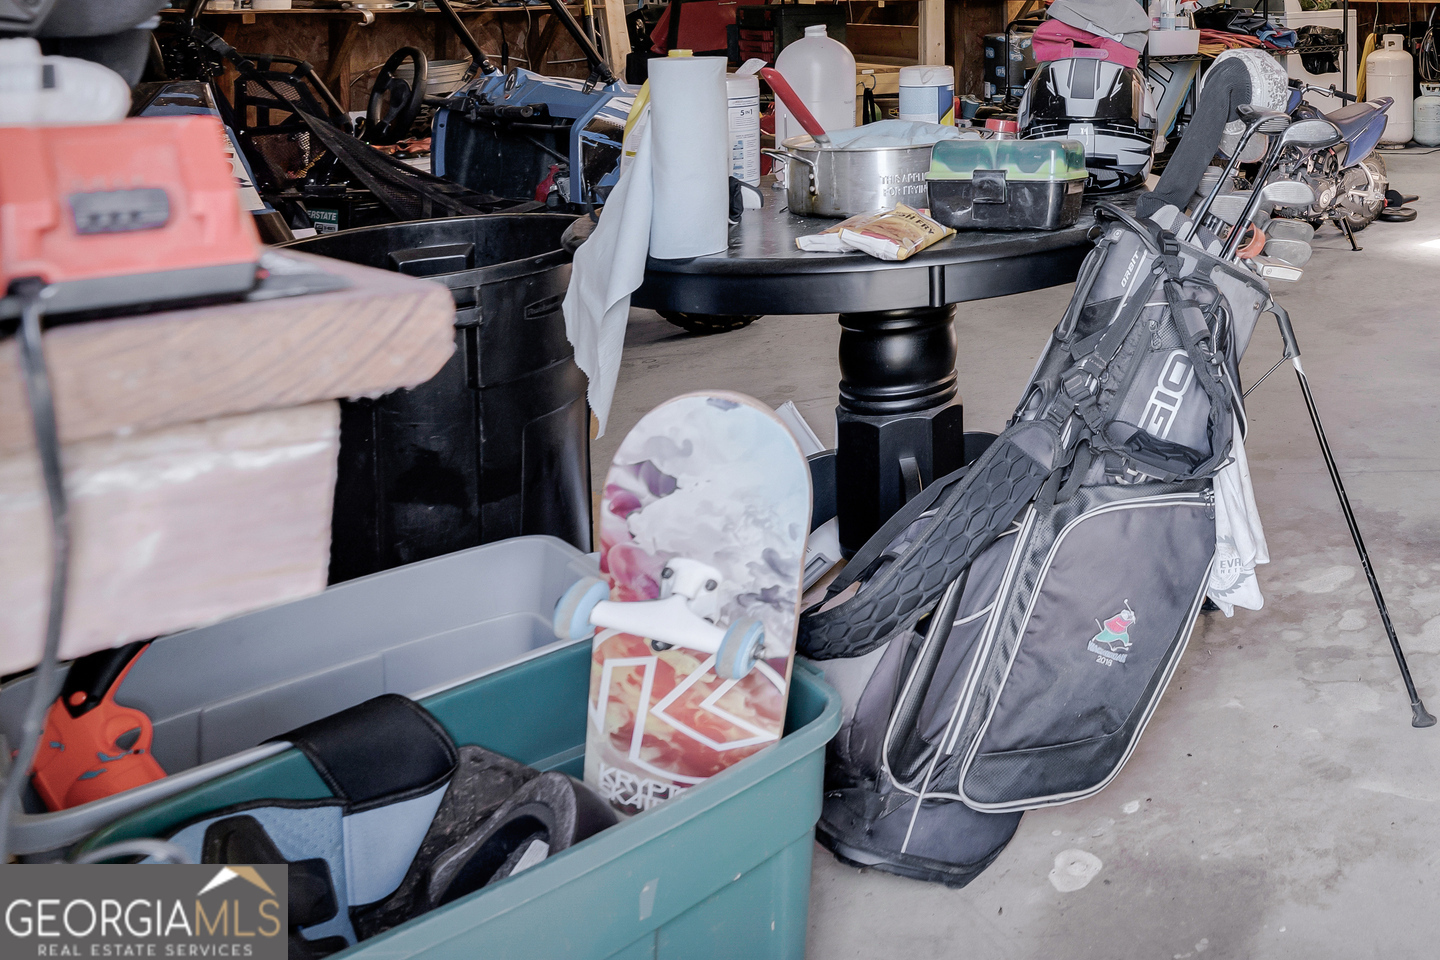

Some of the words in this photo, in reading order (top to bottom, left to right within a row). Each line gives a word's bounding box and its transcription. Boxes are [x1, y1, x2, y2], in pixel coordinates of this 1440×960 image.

[902, 172, 926, 183] APPLI
[307, 210, 337, 220] ERSTATE
[916, 219, 936, 235] FRY
[1120, 250, 1140, 288] ORBIT
[1138, 349, 1194, 439] GIO
[1220, 558, 1243, 568] EVA
